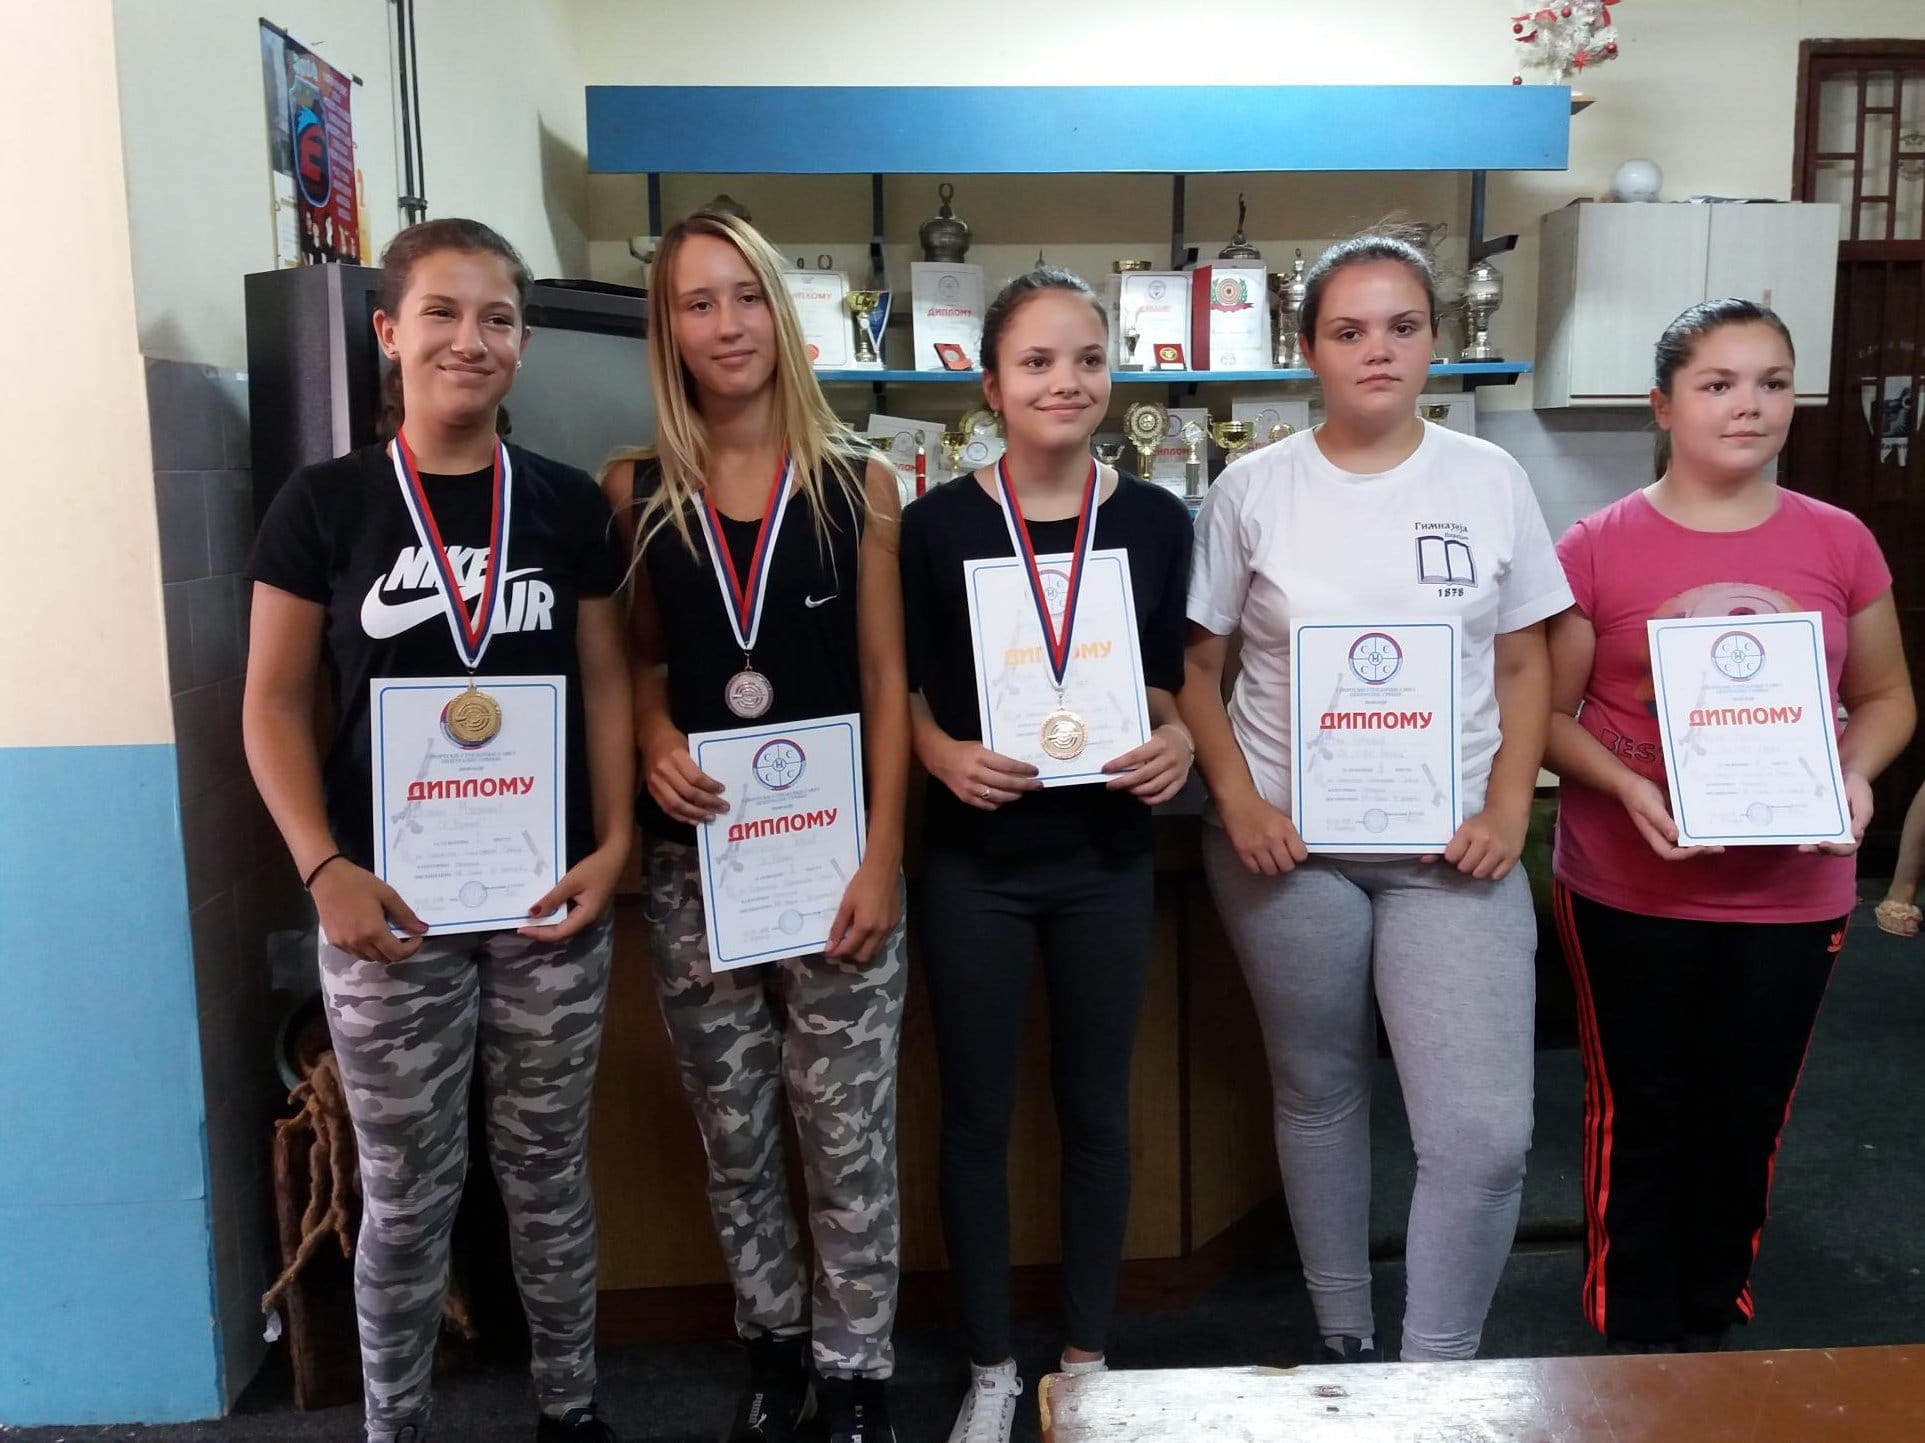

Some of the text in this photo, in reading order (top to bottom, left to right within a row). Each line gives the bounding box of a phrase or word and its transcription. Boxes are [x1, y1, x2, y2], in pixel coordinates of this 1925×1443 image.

[1437, 588, 1464, 597] 1878
[1004, 641, 1112, 667] ДИПМУ
[1319, 711, 1433, 730] ДИПЛОМУ
[1689, 706, 1803, 727] ДИПЛОМУ
[406, 776, 536, 801] ДИПЛОМУ
[728, 808, 839, 842] ДИПЛОМУ
